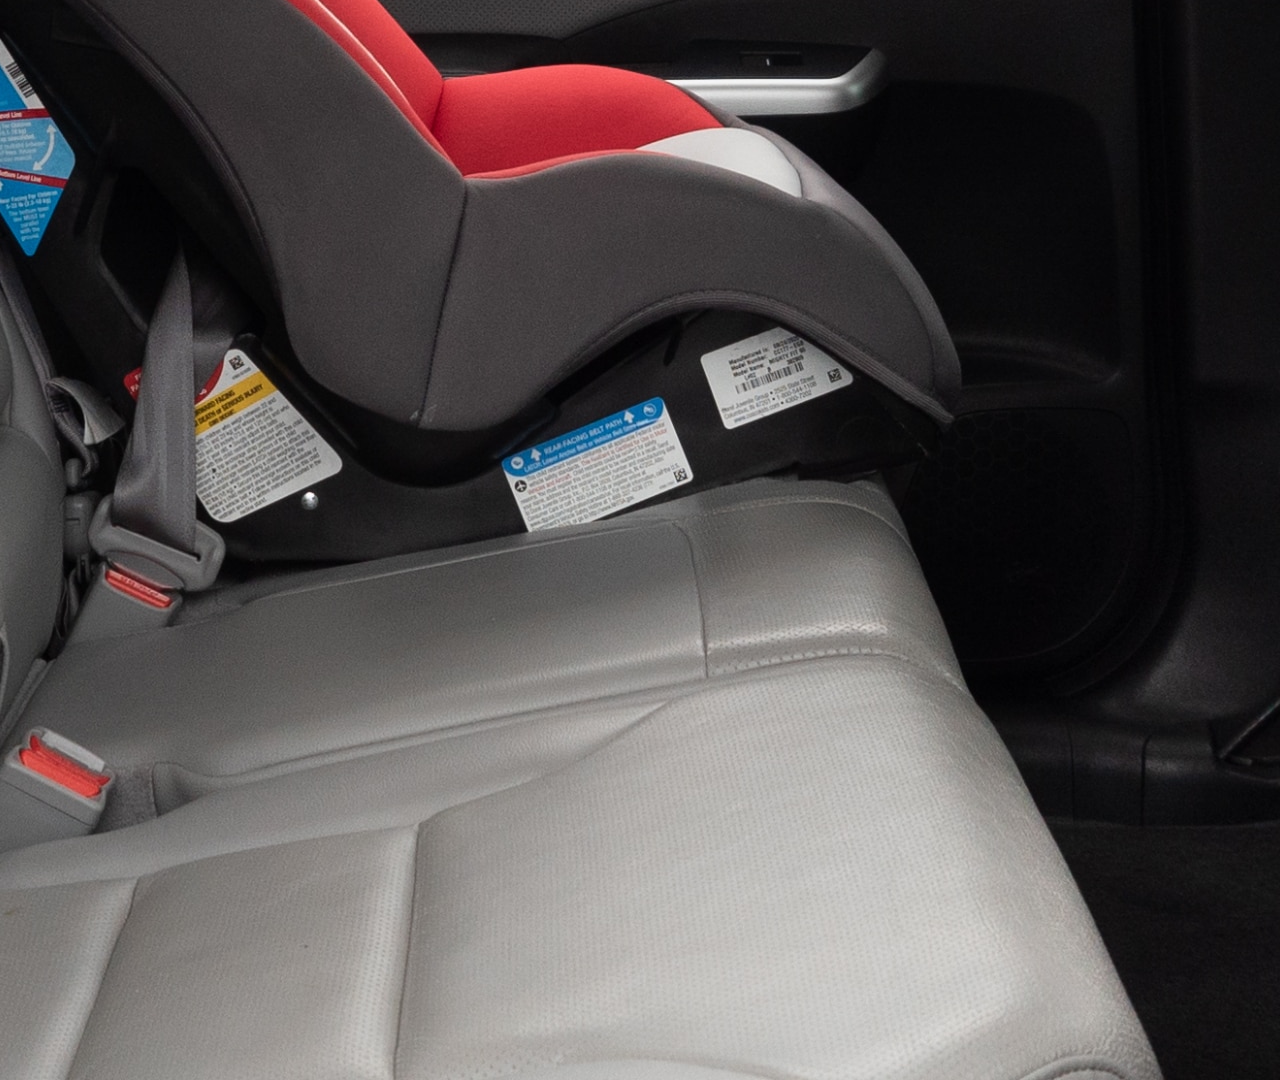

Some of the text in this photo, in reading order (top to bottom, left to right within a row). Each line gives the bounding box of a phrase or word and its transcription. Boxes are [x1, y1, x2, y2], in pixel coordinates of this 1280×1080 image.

[730, 361, 745, 370] Model
[733, 368, 747, 376] Model
[194, 400, 215, 415] RWARD
[215, 389, 234, 403] FACING
[198, 410, 215, 423] DEATH
[221, 394, 243, 410] SERIOUS
[244, 384, 262, 397] INJURY
[588, 425, 604, 436] BELT
[605, 418, 622, 429] PATH
